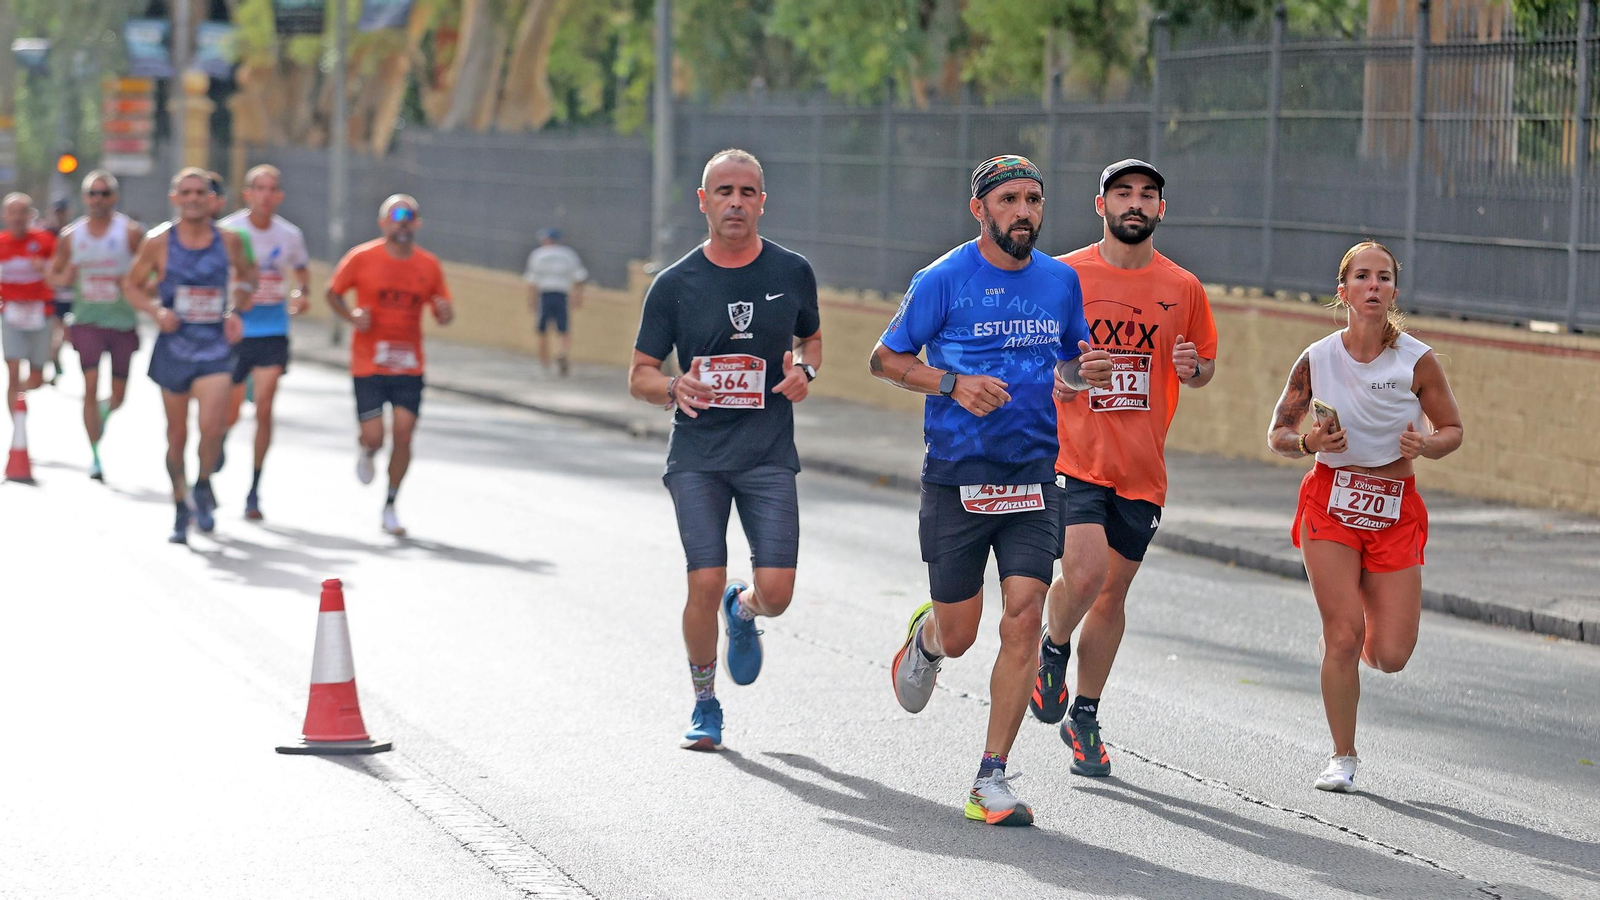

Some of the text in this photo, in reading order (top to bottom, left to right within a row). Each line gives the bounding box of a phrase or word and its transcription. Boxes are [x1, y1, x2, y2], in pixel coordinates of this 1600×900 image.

[985, 287, 1005, 295] GOBIK
[982, 295, 1000, 308] el
[974, 319, 1060, 337] ESTUTIENDA
[711, 373, 749, 391] 364
[1371, 382, 1397, 390] ELITE
[1347, 491, 1386, 514] 270
